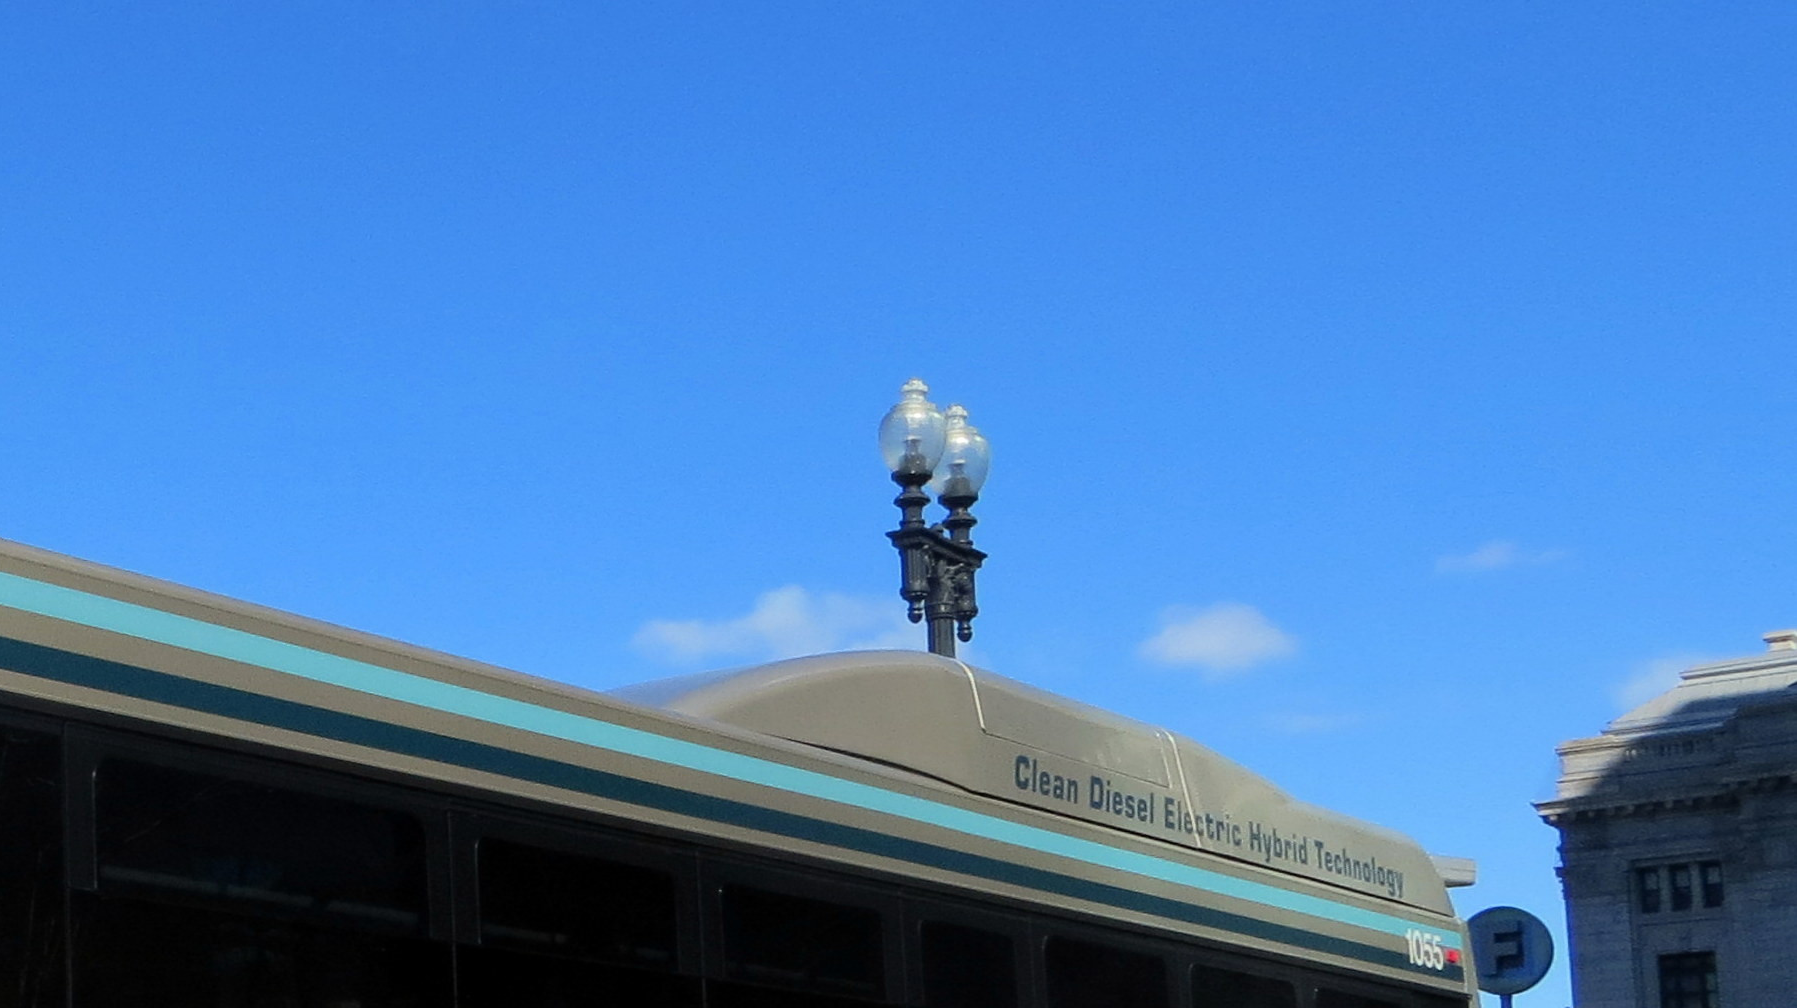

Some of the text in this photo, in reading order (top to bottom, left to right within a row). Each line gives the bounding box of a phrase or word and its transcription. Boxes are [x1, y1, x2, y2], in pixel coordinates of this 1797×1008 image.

[1013, 754, 1404, 899] Clean Diesel Electric Hybrid Technology
[1404, 927, 1445, 971] 1055
